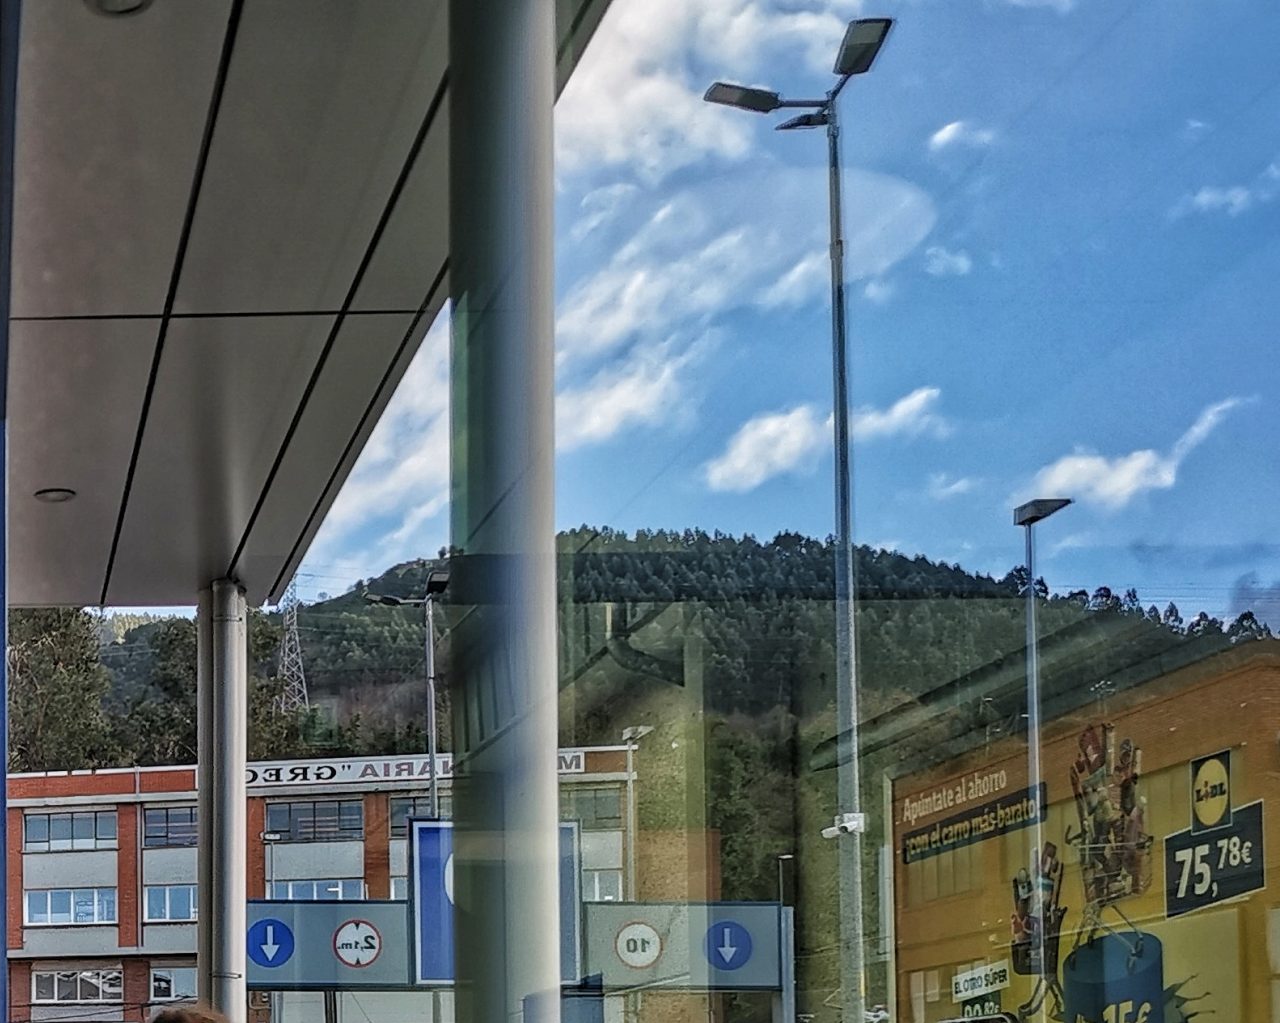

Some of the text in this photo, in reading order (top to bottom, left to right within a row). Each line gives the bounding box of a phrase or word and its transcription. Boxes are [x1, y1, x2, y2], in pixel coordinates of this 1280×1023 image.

[903, 770, 1007, 826] Apúntate al ahorro
[930, 822, 941, 849] el
[942, 820, 970, 845] carro
[971, 808, 995, 835] más
[954, 981, 963, 995] EL
[984, 968, 1007, 987] SÚPER
